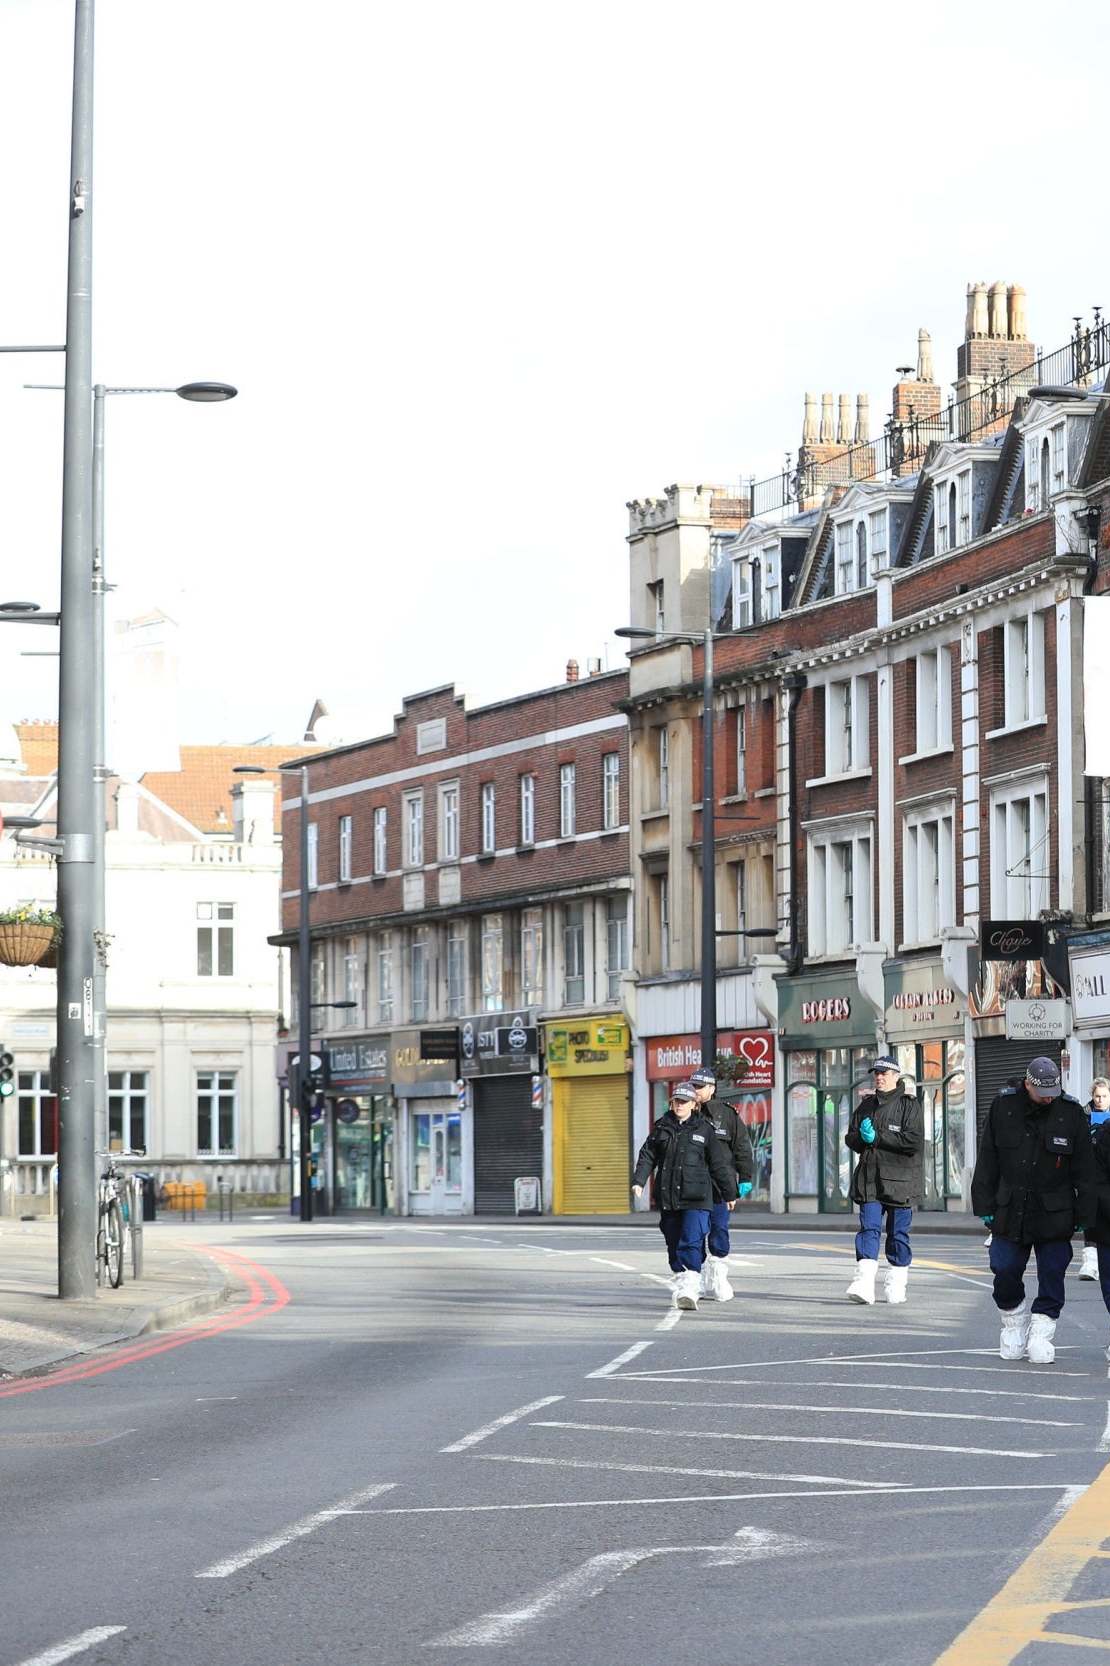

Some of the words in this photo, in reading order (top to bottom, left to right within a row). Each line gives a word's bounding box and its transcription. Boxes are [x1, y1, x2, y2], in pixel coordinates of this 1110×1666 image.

[802, 997, 850, 1023] ROGERS
[1012, 1022, 1047, 1030] WORKING
[1024, 1029, 1055, 1037] CHARITY
[657, 1044, 685, 1067] British
[685, 1044, 702, 1066] Hea
